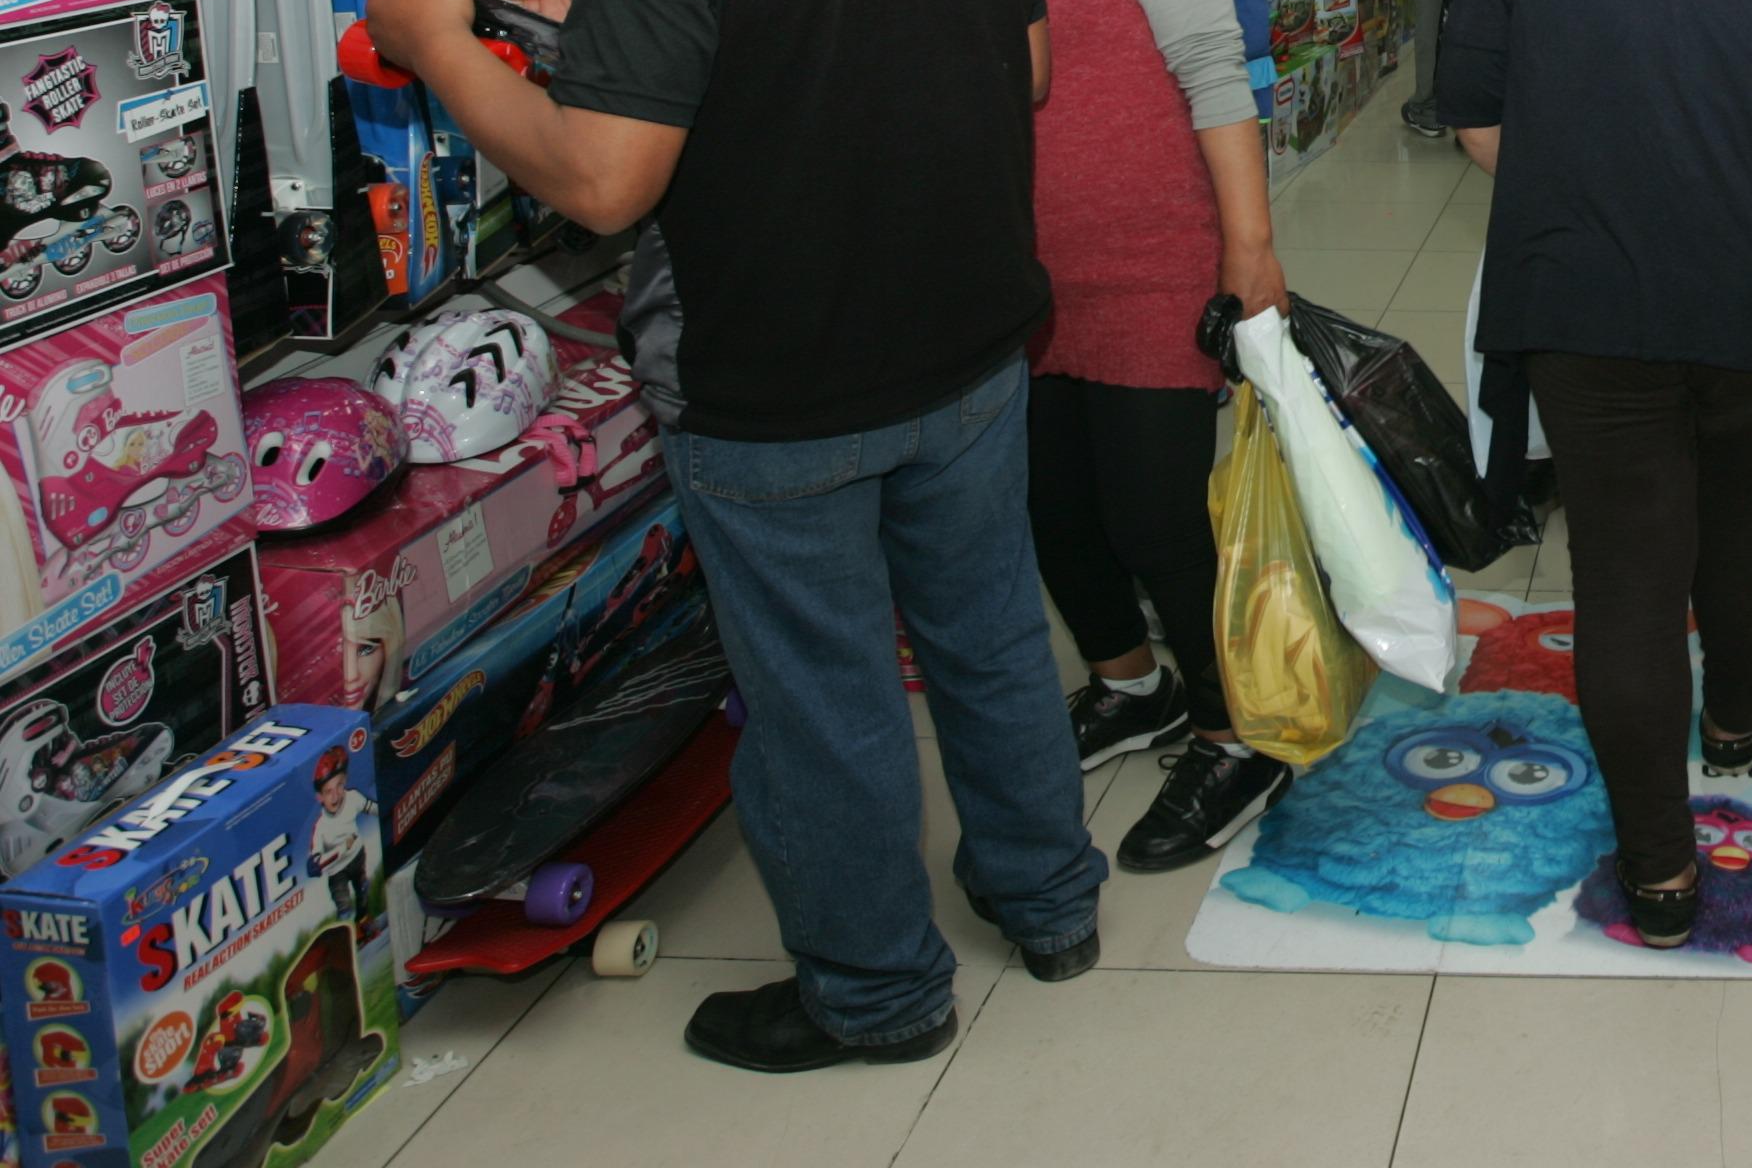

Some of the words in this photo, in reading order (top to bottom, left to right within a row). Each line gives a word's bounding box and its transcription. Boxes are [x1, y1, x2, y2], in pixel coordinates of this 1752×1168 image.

[24, 55, 88, 102] FANGTASTIC
[42, 77, 84, 112] ROLLER
[53, 93, 86, 125] SKATE
[352, 556, 416, 620] Barbie
[28, 605, 79, 648] Skate
[80, 583, 115, 615] Set!
[207, 721, 309, 771] SET
[2, 909, 91, 945] SKATE
[137, 833, 297, 993] SKATE
[211, 933, 253, 971] ACTION
